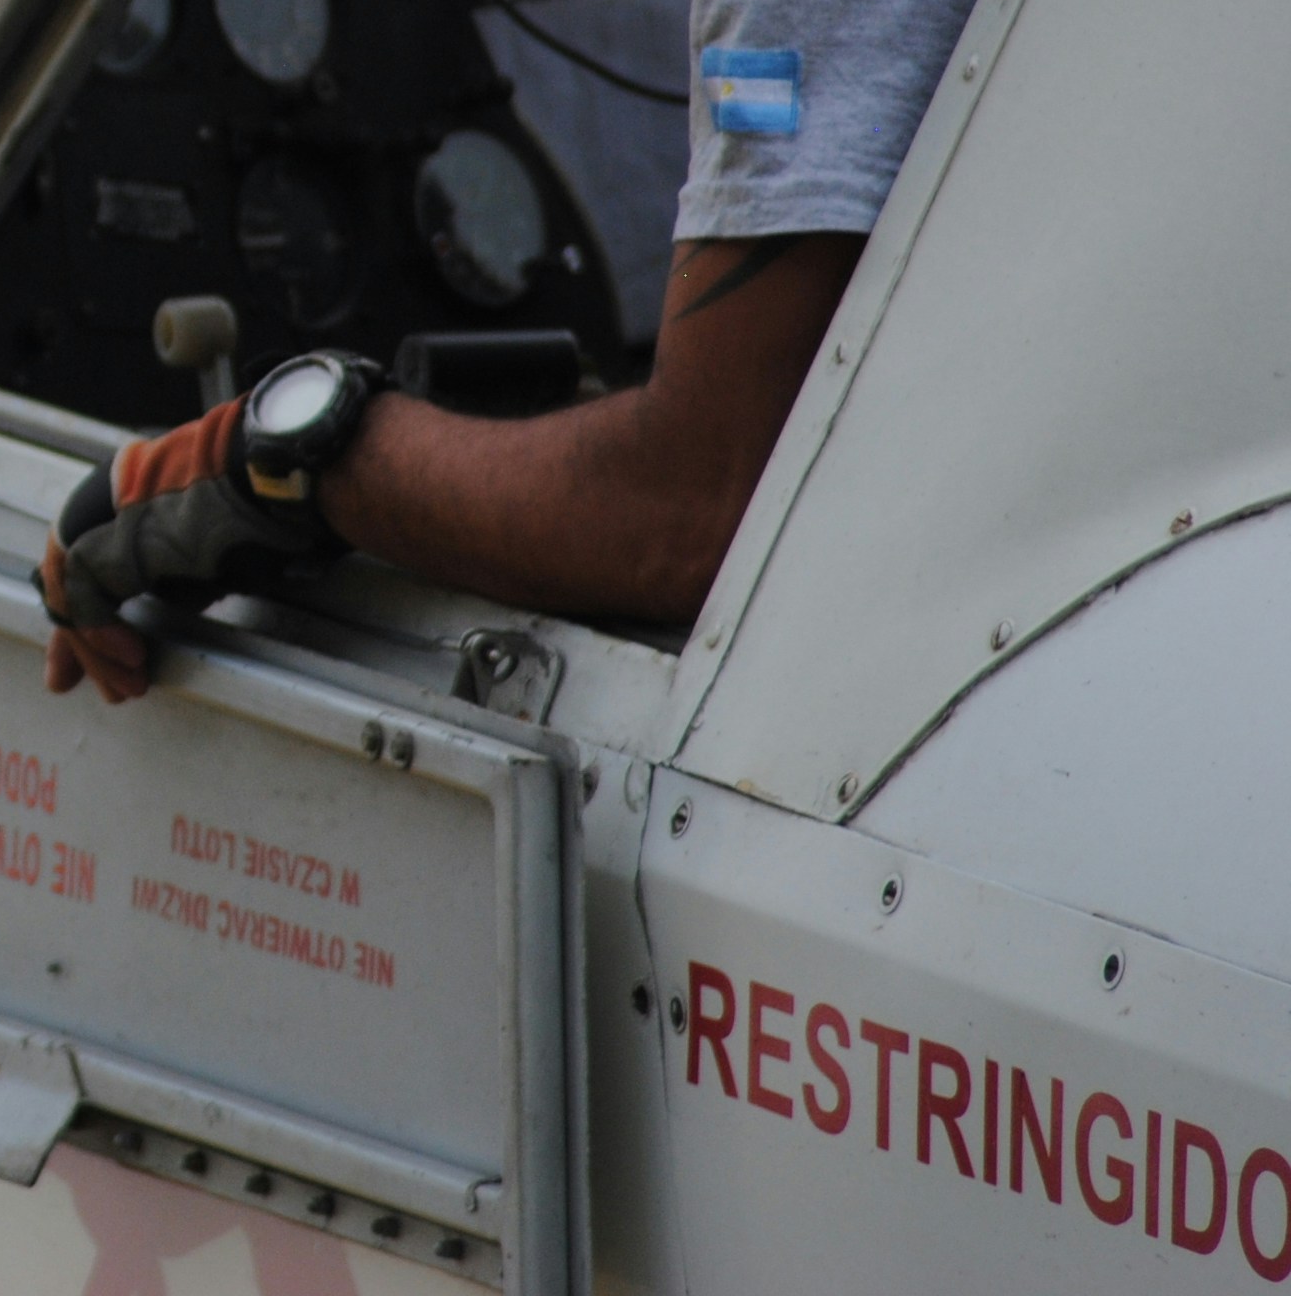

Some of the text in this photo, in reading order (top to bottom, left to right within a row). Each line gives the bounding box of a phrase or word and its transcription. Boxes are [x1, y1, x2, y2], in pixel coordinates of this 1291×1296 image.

[52, 842, 96, 904] NIE
[171, 814, 361, 907] W CZASIE LOTU
[132, 876, 209, 932] DRZWI
[355, 939, 395, 988] NIE
[686, 959, 1291, 1283] RESTRINGIDO
